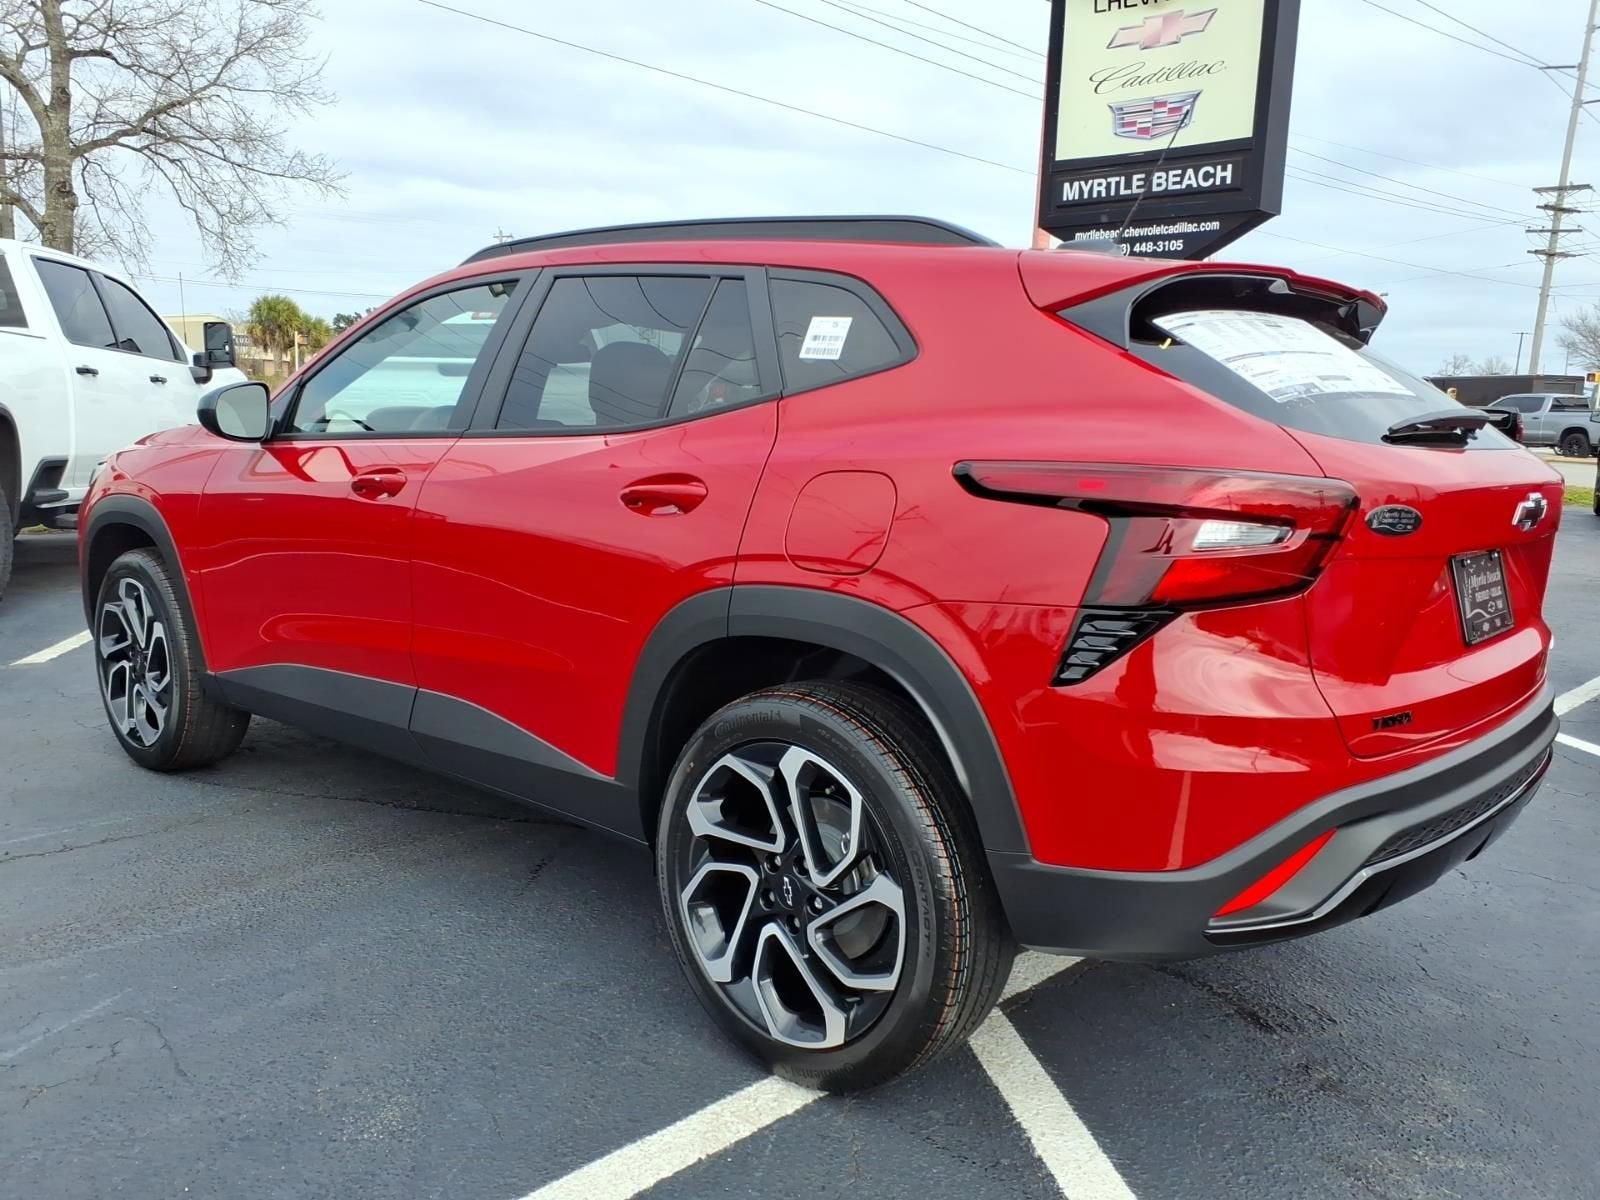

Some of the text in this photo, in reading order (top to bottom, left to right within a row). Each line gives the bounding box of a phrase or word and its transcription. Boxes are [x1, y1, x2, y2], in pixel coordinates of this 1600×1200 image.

[1089, 60, 1225, 95] Cadillac
[1062, 163, 1233, 201] MYRTLE BEACH
[1133, 239, 1184, 254] 448-3105
